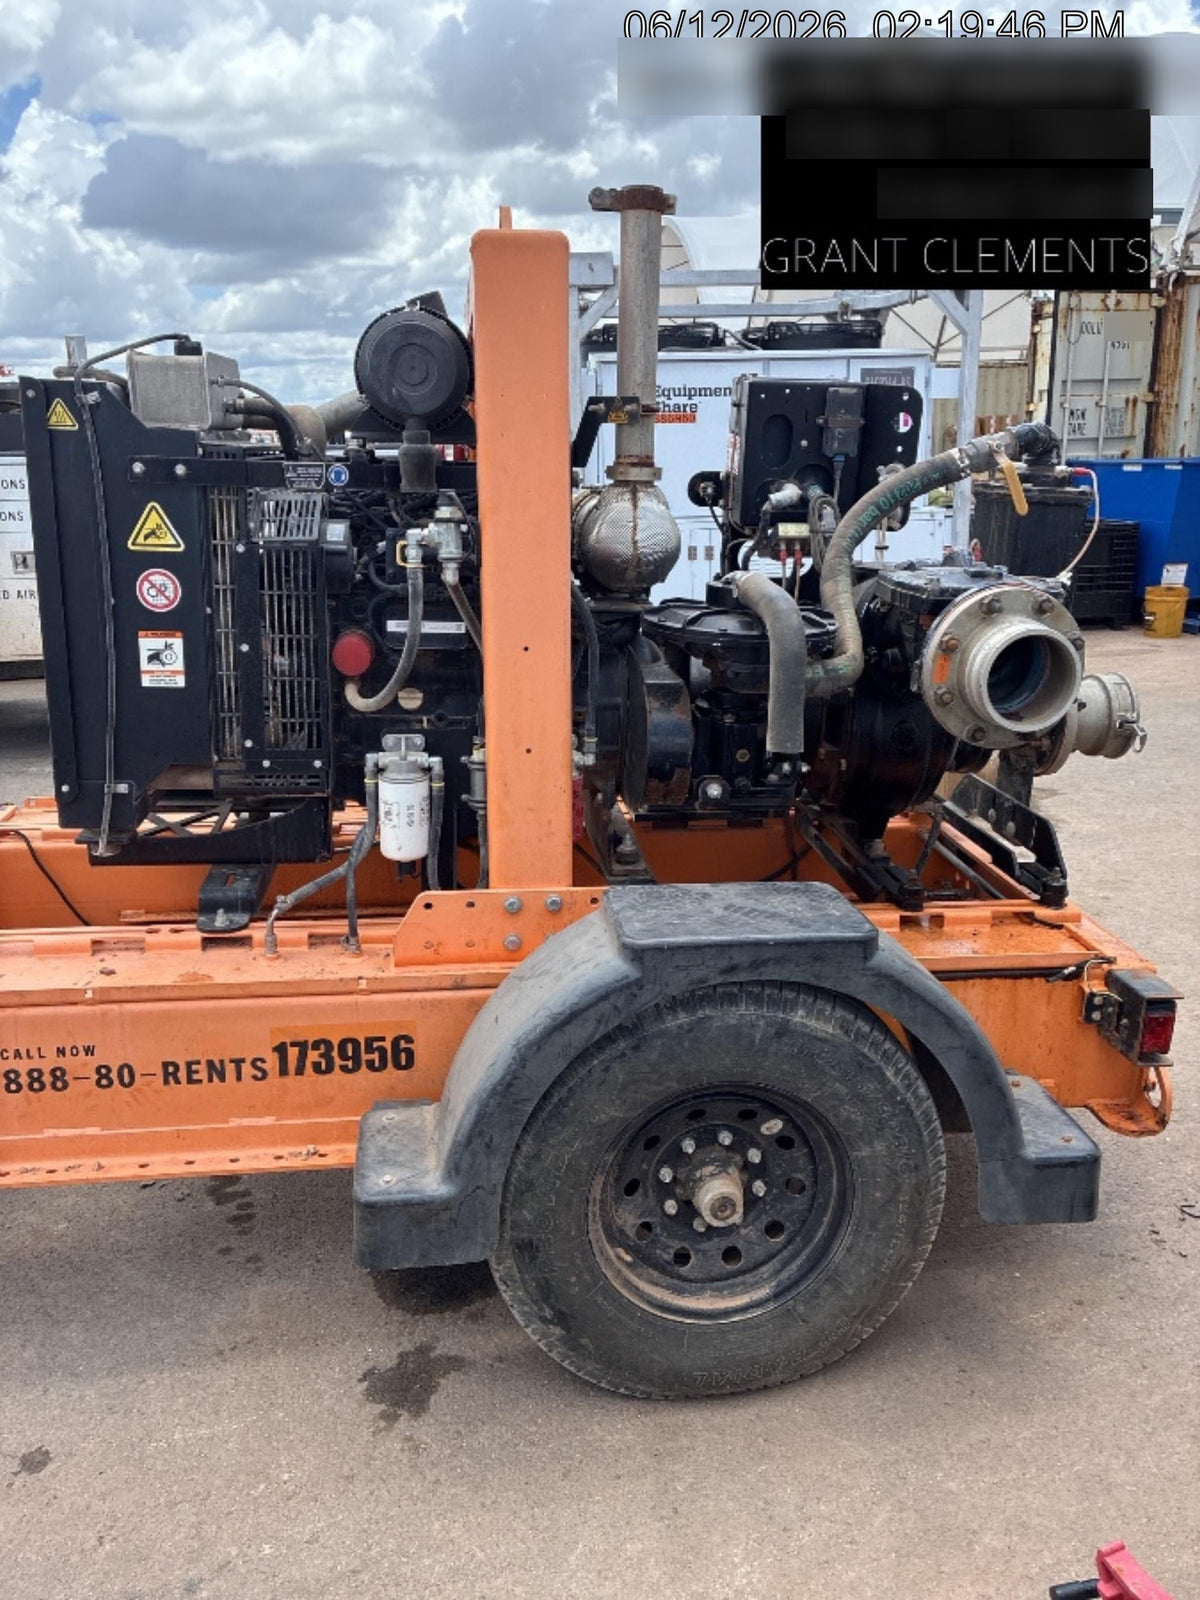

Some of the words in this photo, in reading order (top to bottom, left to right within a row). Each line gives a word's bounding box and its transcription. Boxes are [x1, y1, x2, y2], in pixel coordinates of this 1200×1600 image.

[656, 383, 732, 401] Equipmen
[1, 1047, 46, 1061] CALL
[56, 1045, 96, 1058] NOW
[271, 1034, 416, 1077] 173956
